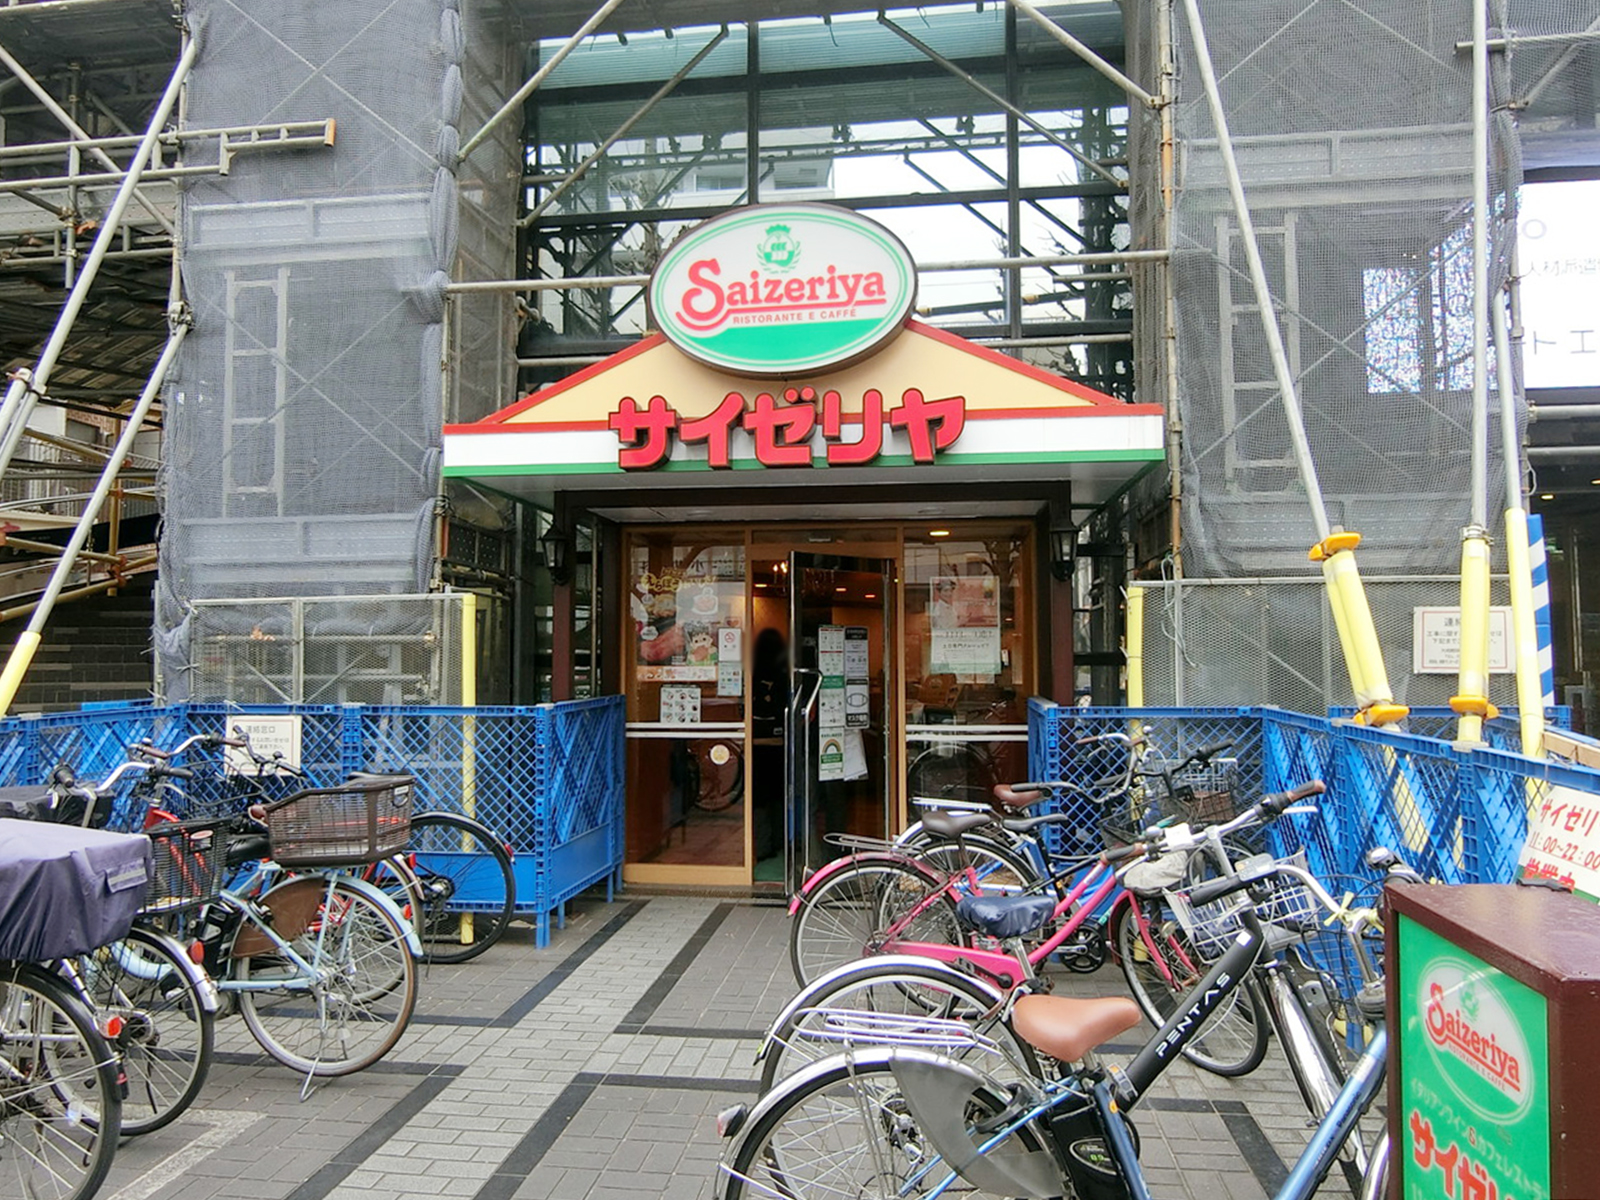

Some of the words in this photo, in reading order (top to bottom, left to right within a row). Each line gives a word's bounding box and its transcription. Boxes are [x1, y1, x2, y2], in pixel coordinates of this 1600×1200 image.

[676, 258, 887, 331] Saizeriya
[1526, 258, 1600, 277] 人材派遣
[733, 313, 803, 325] RISTORANTE
[808, 312, 815, 320] E
[608, 387, 965, 470] サイゼリヤ
[1155, 972, 1231, 1057] PENTAS
[1426, 982, 1521, 1092] Saizeriya
